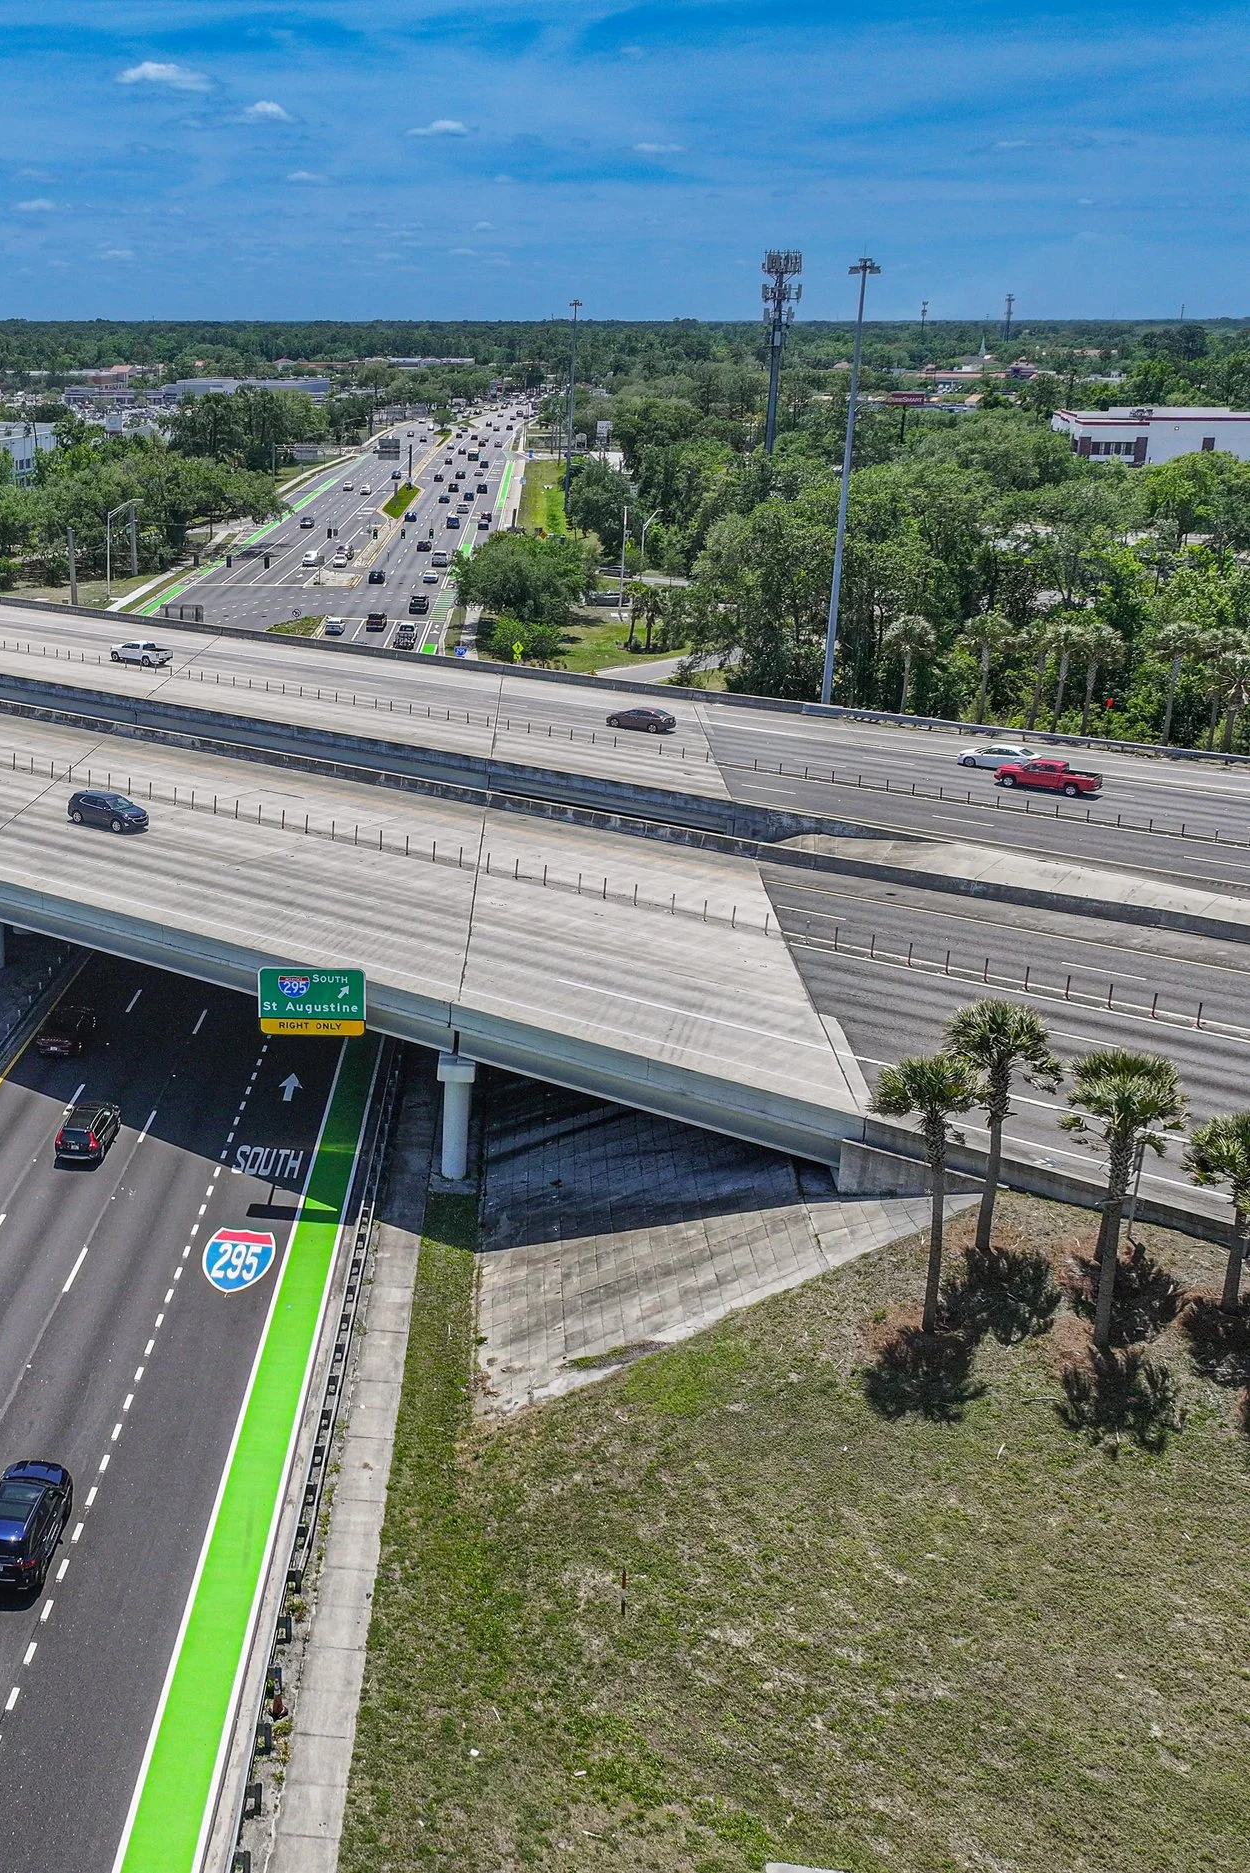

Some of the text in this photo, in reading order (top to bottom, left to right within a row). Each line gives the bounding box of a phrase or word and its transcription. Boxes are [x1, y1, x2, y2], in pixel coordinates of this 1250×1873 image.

[284, 974, 348, 993] 295 SOUTH
[263, 1002, 358, 1014] St Augustine
[279, 1022, 342, 1030] RIGHT ONLY
[231, 1145, 304, 1179] SOUTH
[210, 1243, 263, 1281] 295
